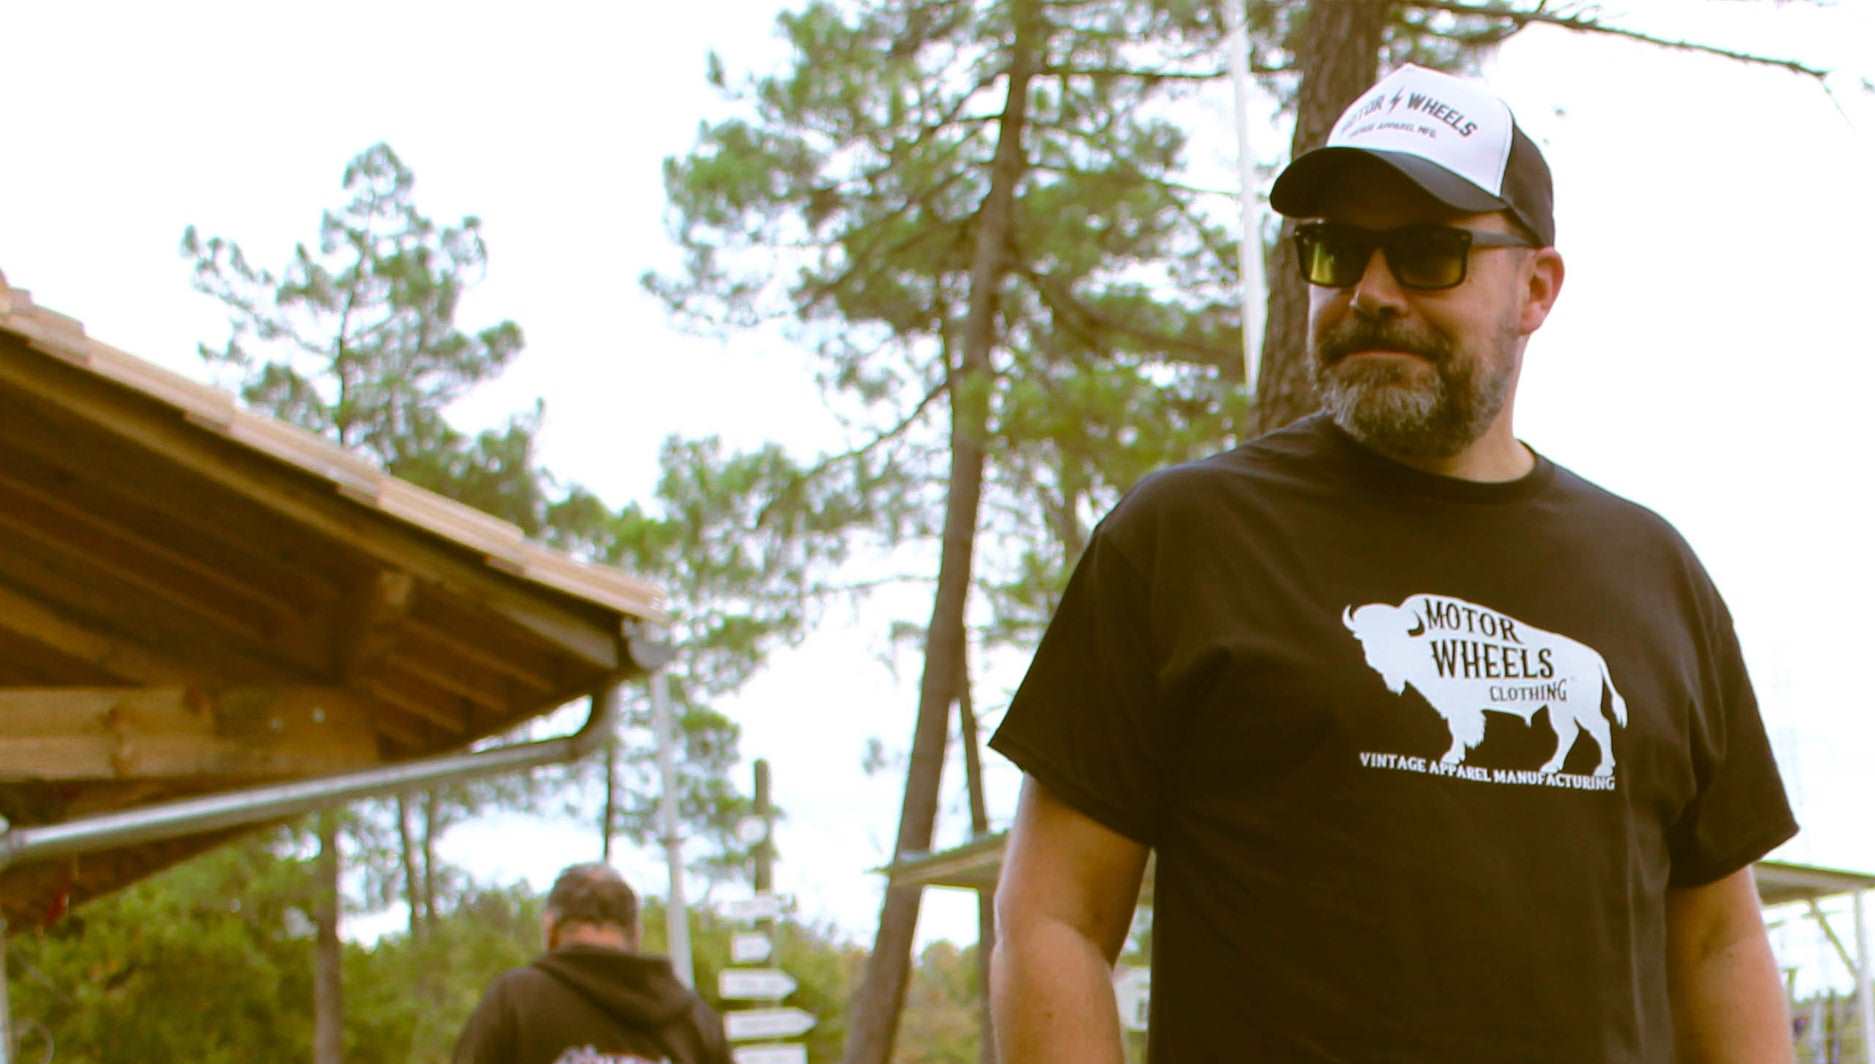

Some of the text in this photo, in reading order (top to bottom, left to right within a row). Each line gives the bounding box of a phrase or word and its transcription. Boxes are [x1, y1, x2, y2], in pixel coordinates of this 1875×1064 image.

[1406, 92, 1478, 138] WHEELS
[1424, 599, 1521, 644] MOTOR
[1430, 639, 1555, 679] WHEELS
[1489, 679, 1568, 703] CLOTHING
[1359, 752, 1616, 791] VINTAGE APPAREL MANUFACTURING
